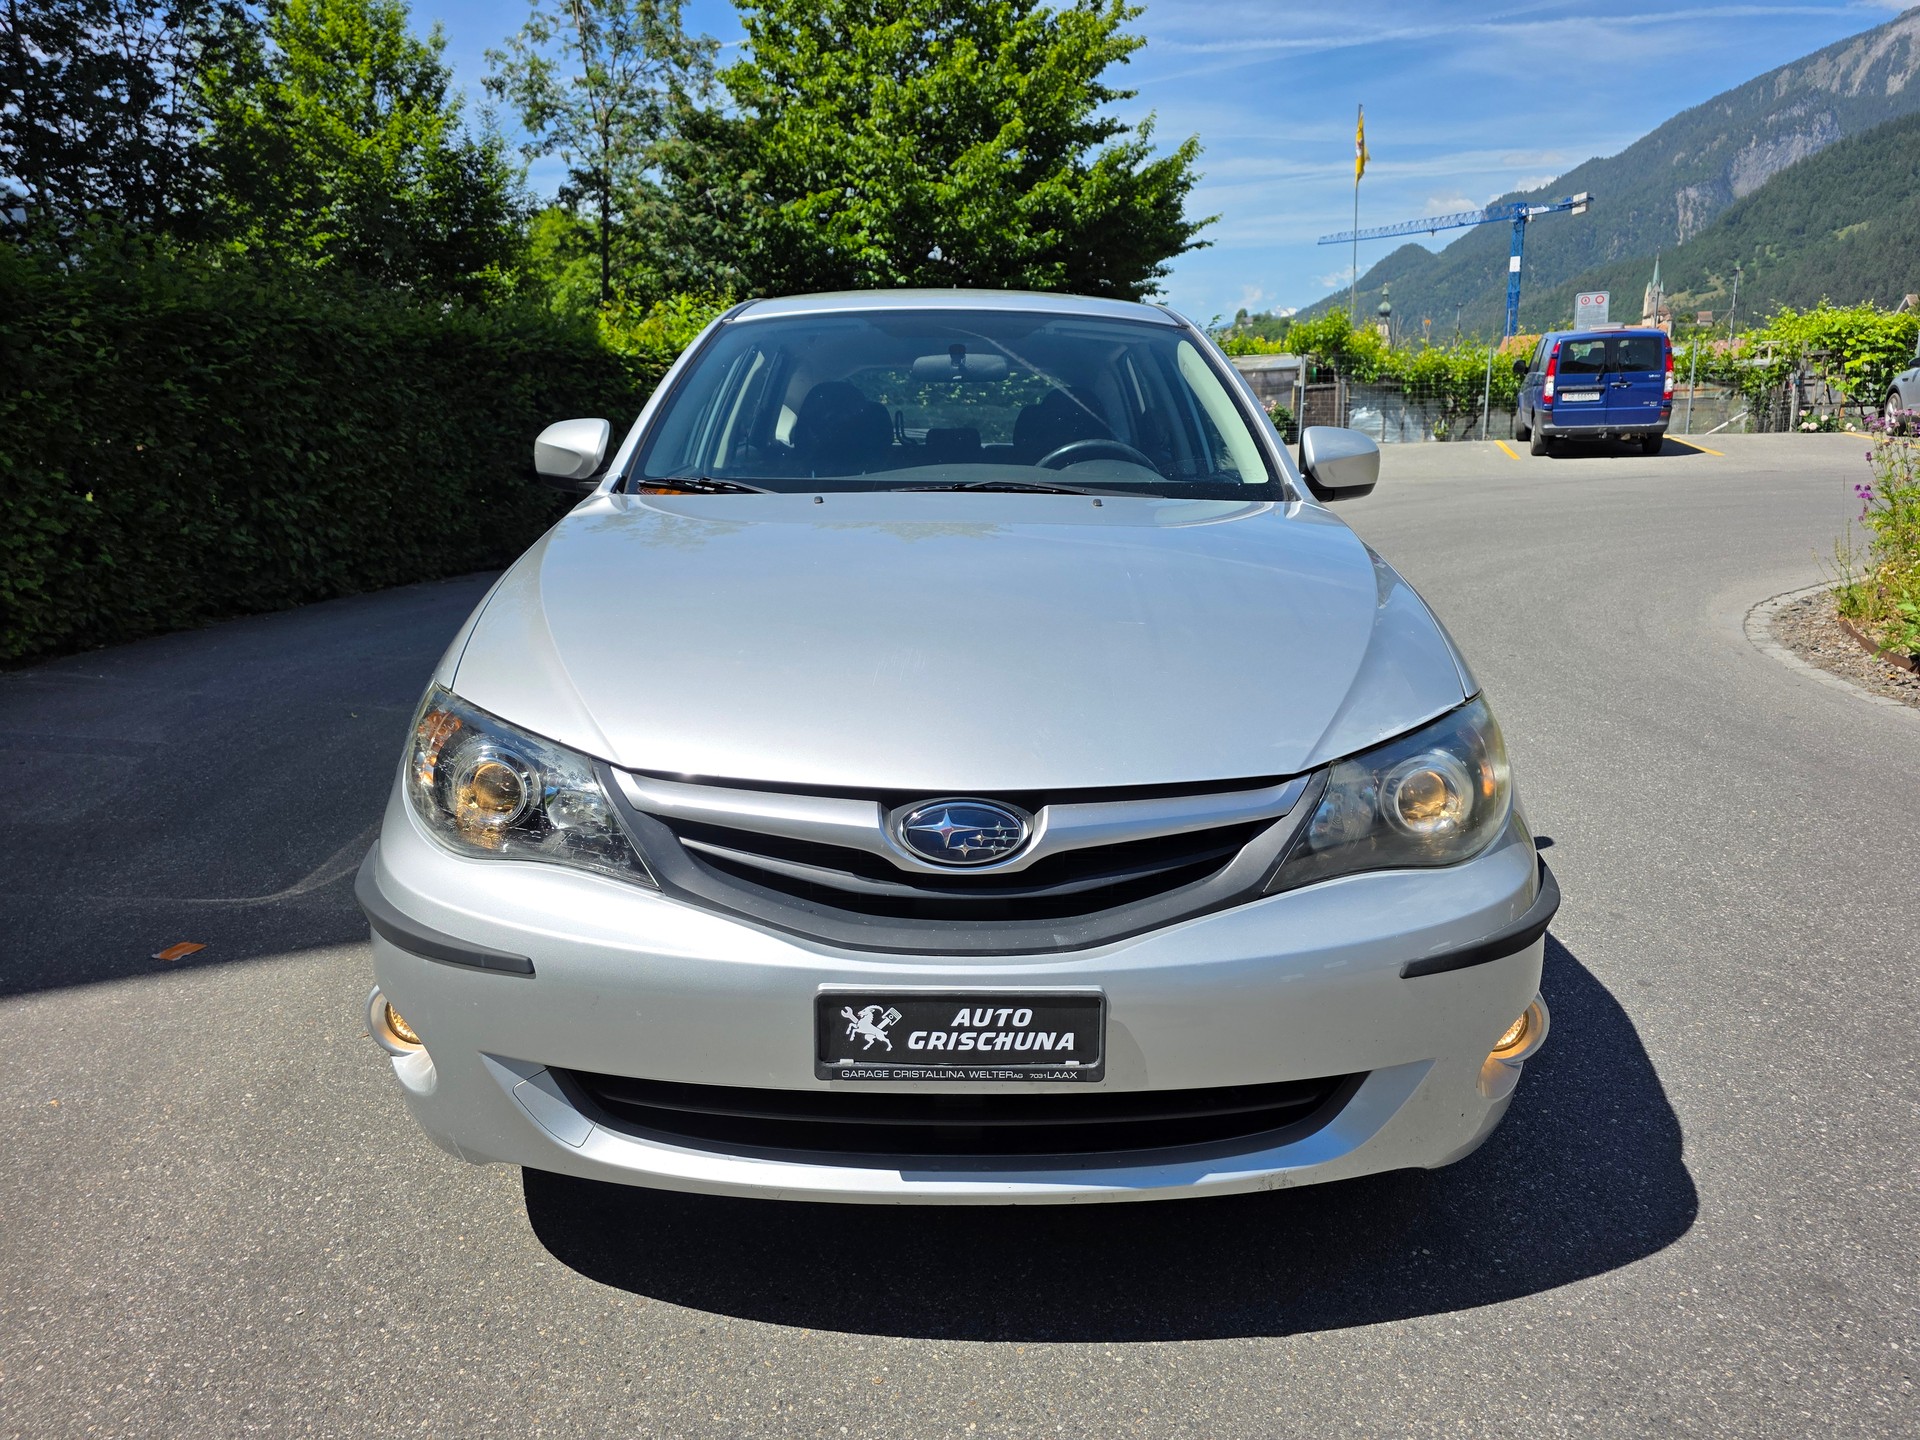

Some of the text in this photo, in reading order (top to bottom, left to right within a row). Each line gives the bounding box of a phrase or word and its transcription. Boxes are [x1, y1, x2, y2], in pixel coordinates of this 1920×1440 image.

[950, 1008, 1033, 1027] AUTO
[907, 1031, 1075, 1051] GRISCHUNA
[841, 1069, 890, 1078] GARAGE
[893, 1070, 966, 1079] CRISTALLINA
[1047, 1071, 1078, 1079] LAAX
